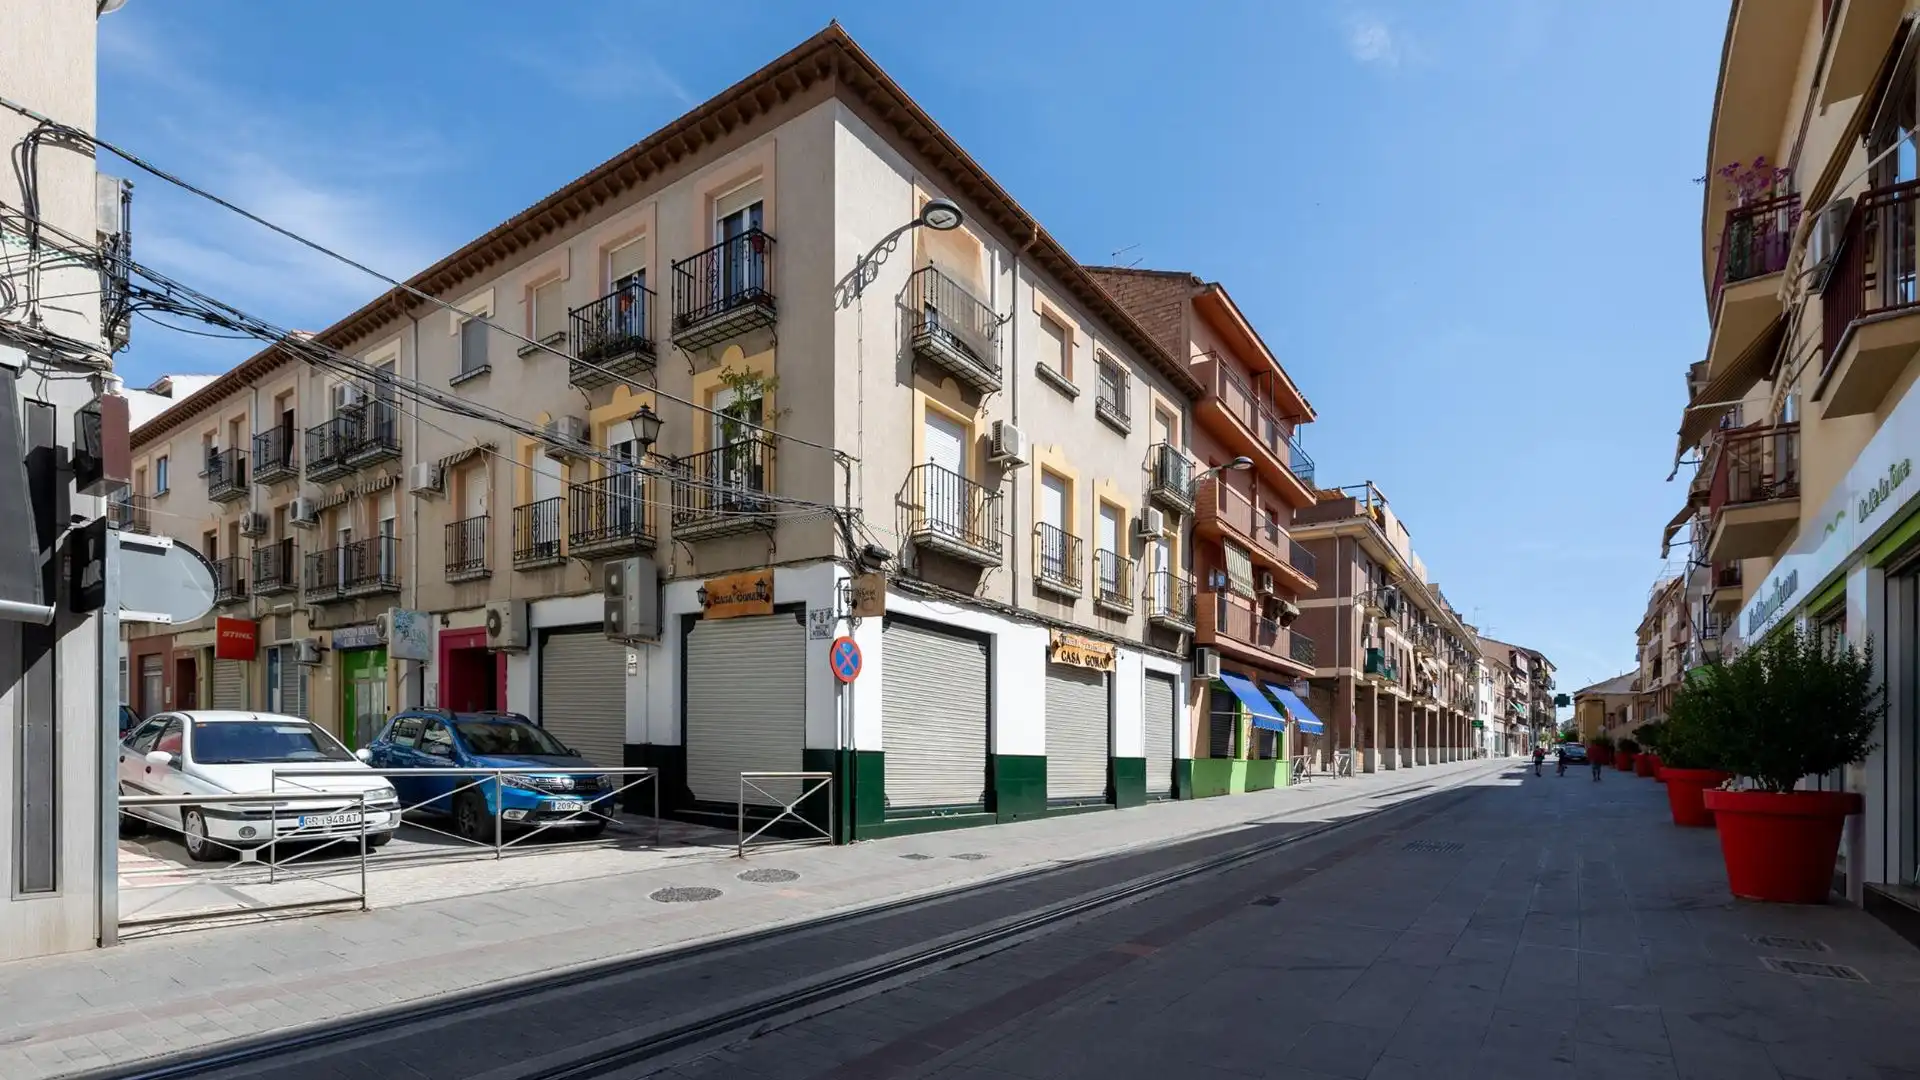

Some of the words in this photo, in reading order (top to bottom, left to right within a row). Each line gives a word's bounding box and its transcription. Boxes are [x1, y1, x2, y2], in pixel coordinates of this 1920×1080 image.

[222, 630, 253, 640] STIHL
[1060, 649, 1081, 665] CASA
[556, 801, 575, 811] 2097
